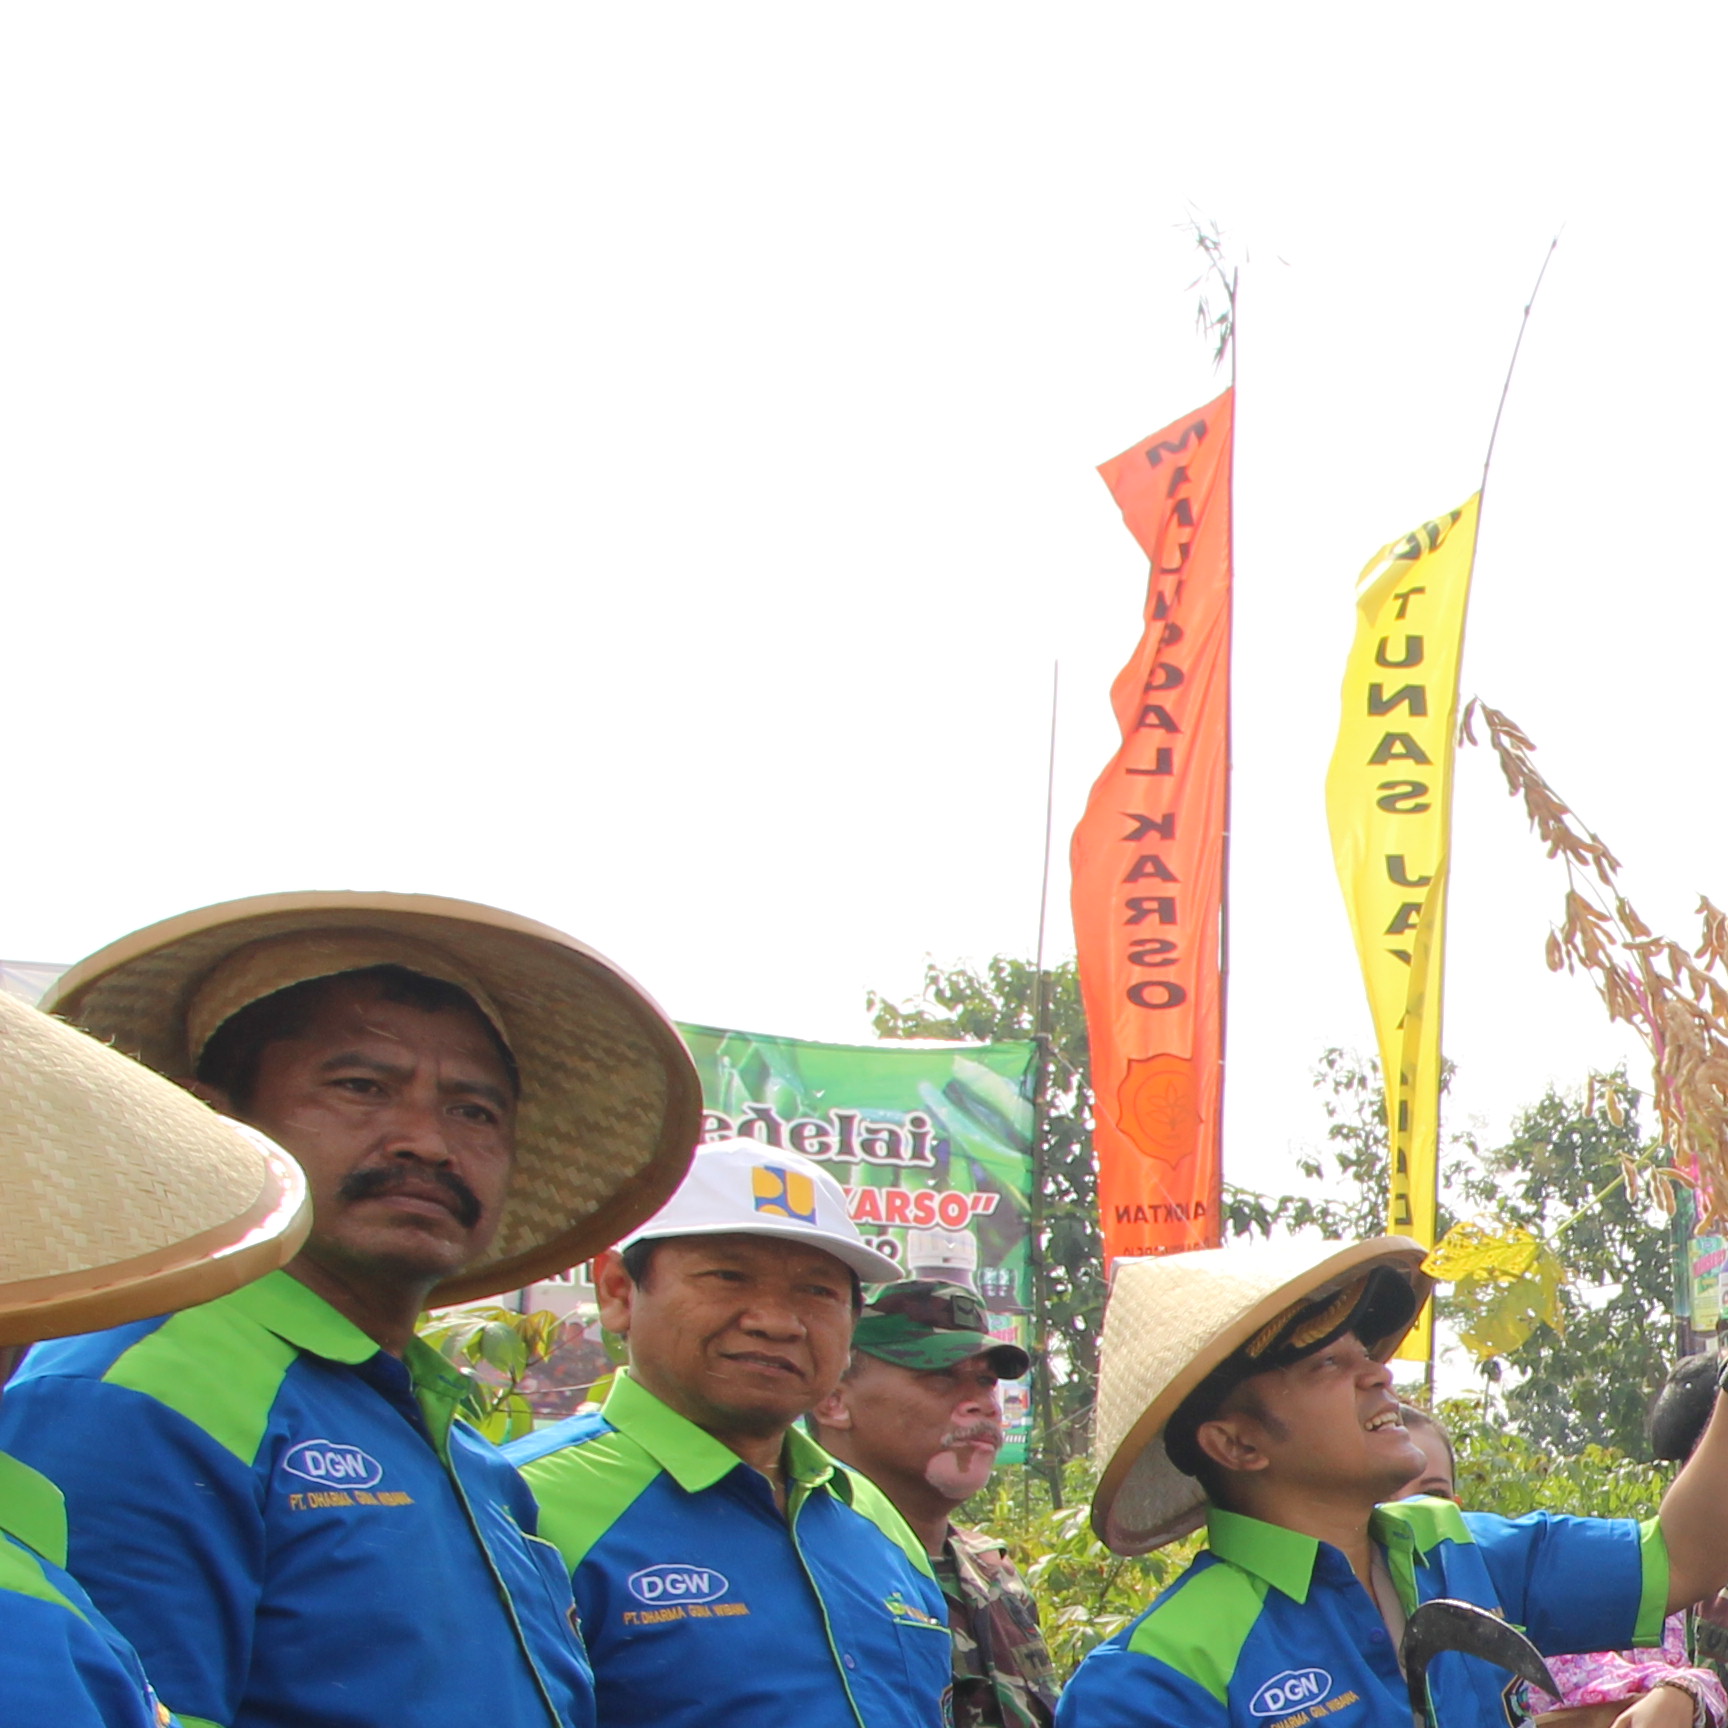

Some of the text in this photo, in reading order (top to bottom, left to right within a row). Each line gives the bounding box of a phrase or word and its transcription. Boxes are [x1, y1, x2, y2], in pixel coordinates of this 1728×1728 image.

[842, 1186, 998, 1228] ARSO"
[303, 1450, 368, 1479] DGW
[640, 1572, 710, 1599] DGW
[640, 1605, 687, 1624] DHARMA
